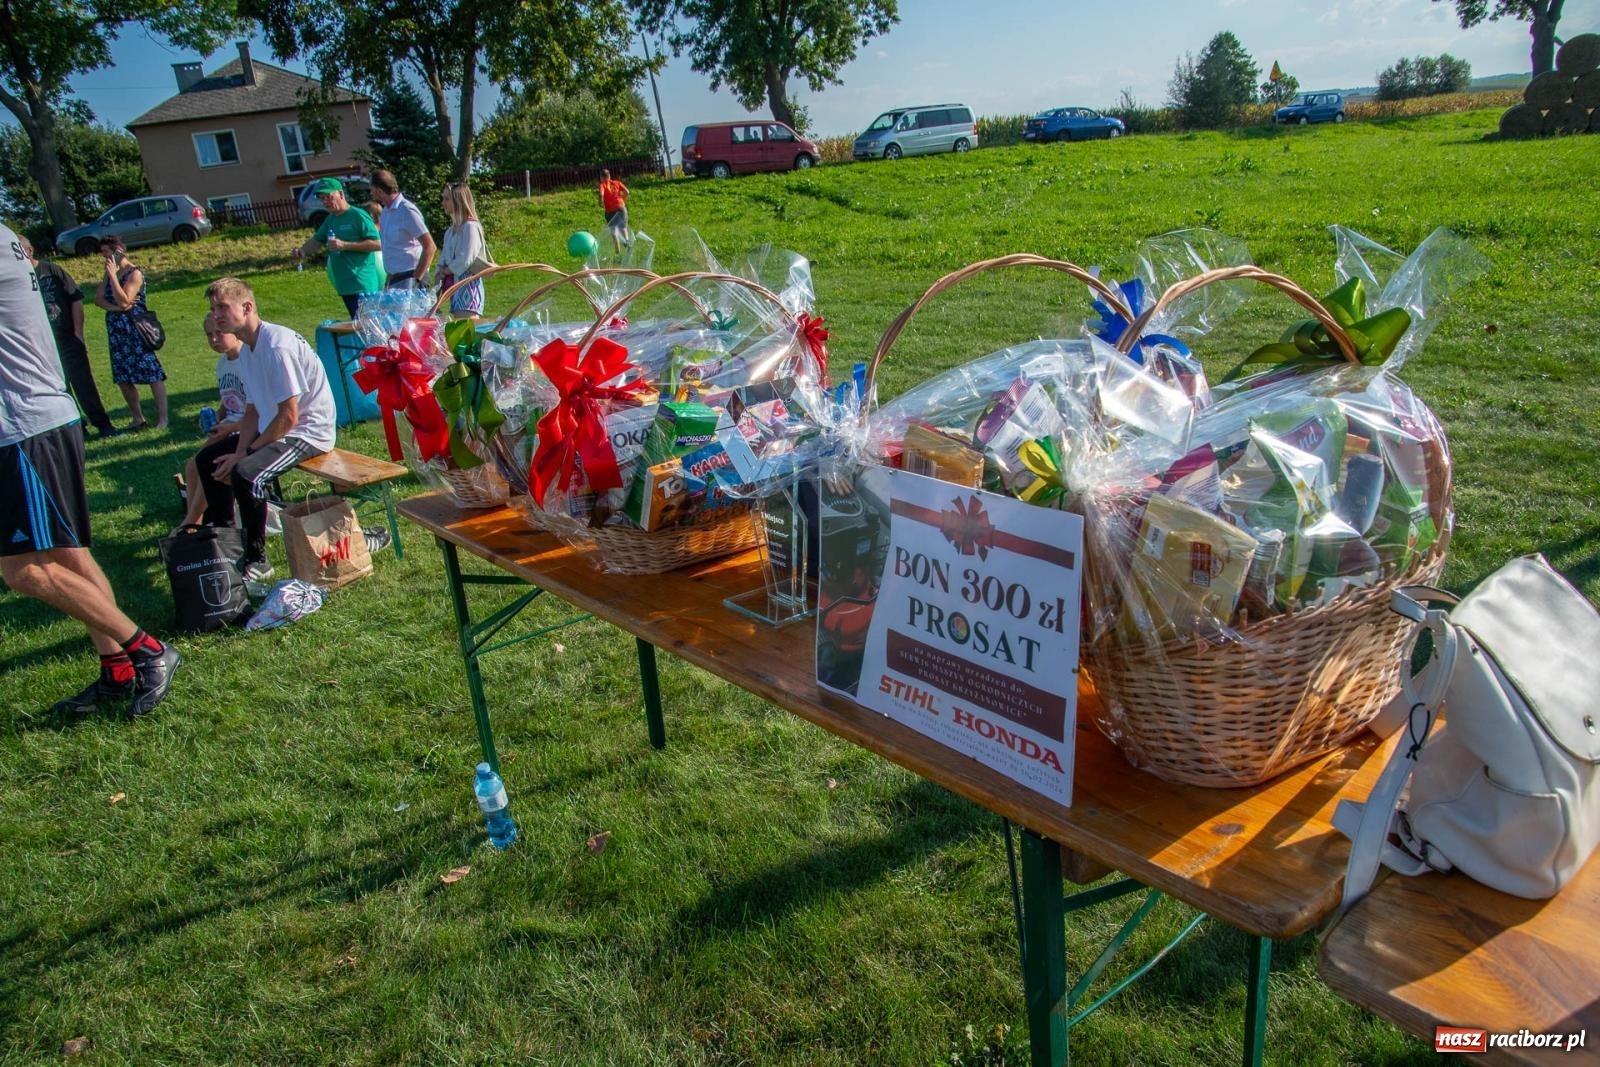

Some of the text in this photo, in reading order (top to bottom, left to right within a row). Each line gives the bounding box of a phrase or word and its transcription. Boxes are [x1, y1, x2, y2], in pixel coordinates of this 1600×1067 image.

[607, 421, 655, 448] OKA
[676, 435, 712, 443] MICHASZKI
[176, 562, 202, 573] Gmina
[894, 545, 1066, 634] BON 300 zł
[907, 595, 1041, 673] PROSAT
[878, 674, 1065, 774] STIHL HONDA
